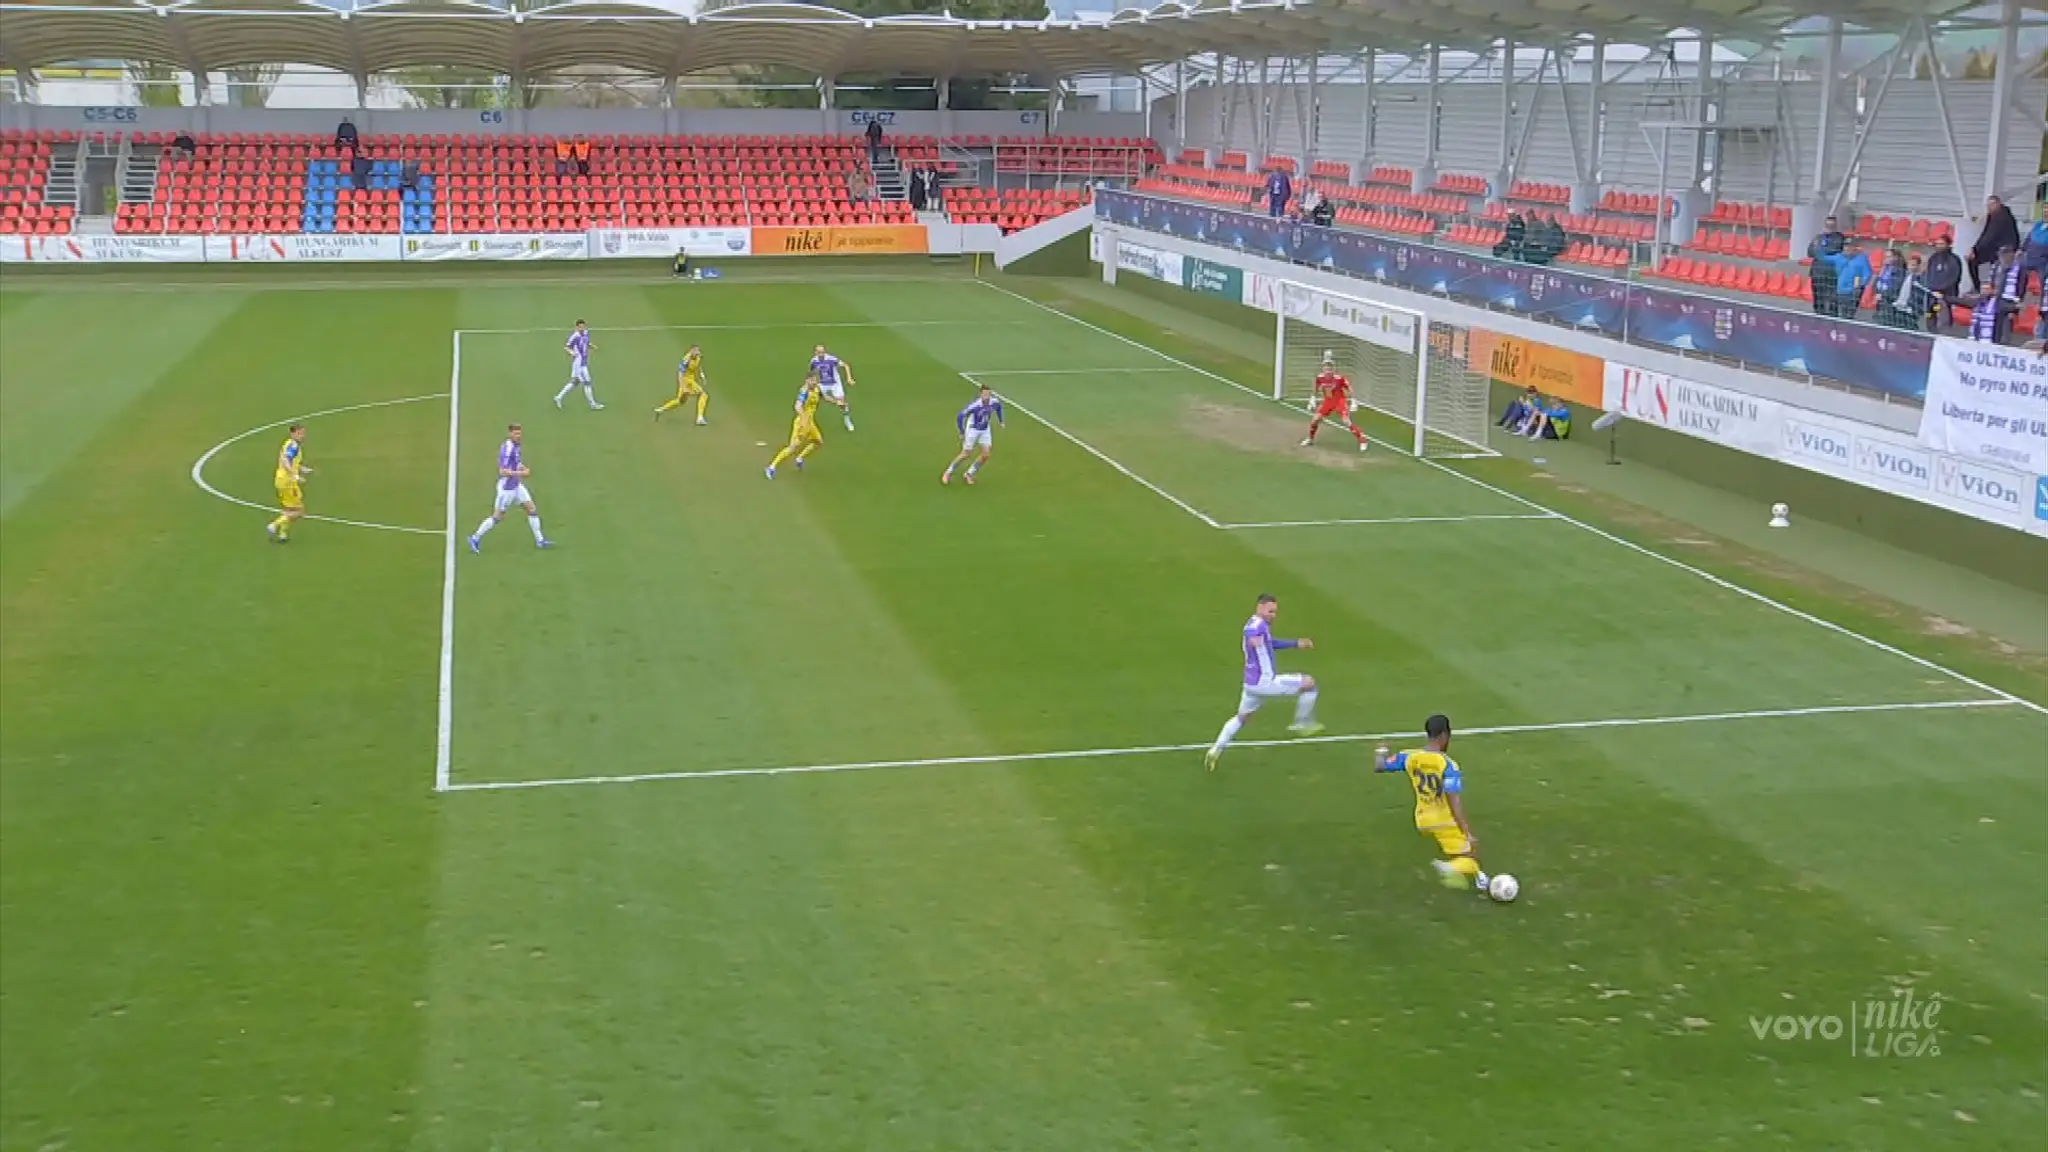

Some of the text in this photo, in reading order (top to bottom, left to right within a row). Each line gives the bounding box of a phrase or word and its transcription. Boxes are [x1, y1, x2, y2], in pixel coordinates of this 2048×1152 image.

[1976, 351, 2027, 373] ULTRAS
[1979, 379, 2007, 393] pyro
[2010, 381, 2030, 397] NO
[1986, 415, 2009, 429] per
[1800, 431, 1847, 459] ViOn
[1875, 451, 1928, 480] ViOn
[1961, 473, 2019, 504] ViOn
[1413, 767, 1443, 798] 29
